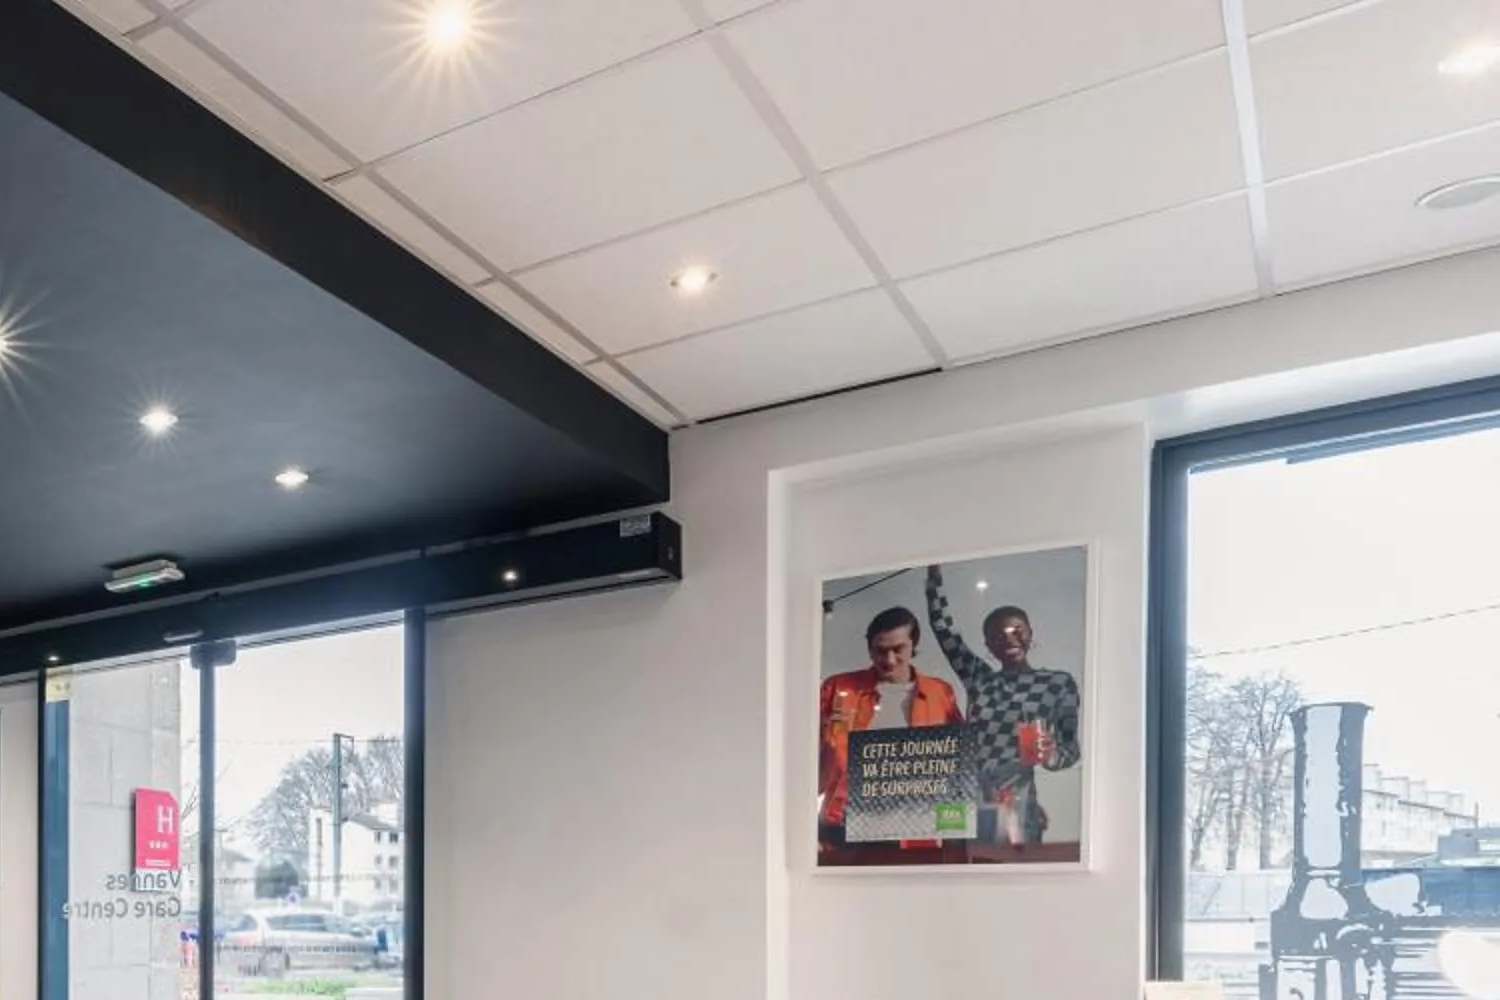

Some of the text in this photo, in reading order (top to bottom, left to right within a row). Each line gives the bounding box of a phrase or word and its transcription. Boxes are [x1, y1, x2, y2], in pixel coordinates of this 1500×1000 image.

[863, 736, 958, 759] CETTE JOURNÉE
[881, 760, 911, 778] ÊTRE
[913, 759, 958, 775] PLEINE
[862, 782, 878, 797] DE
[157, 805, 173, 833] H
